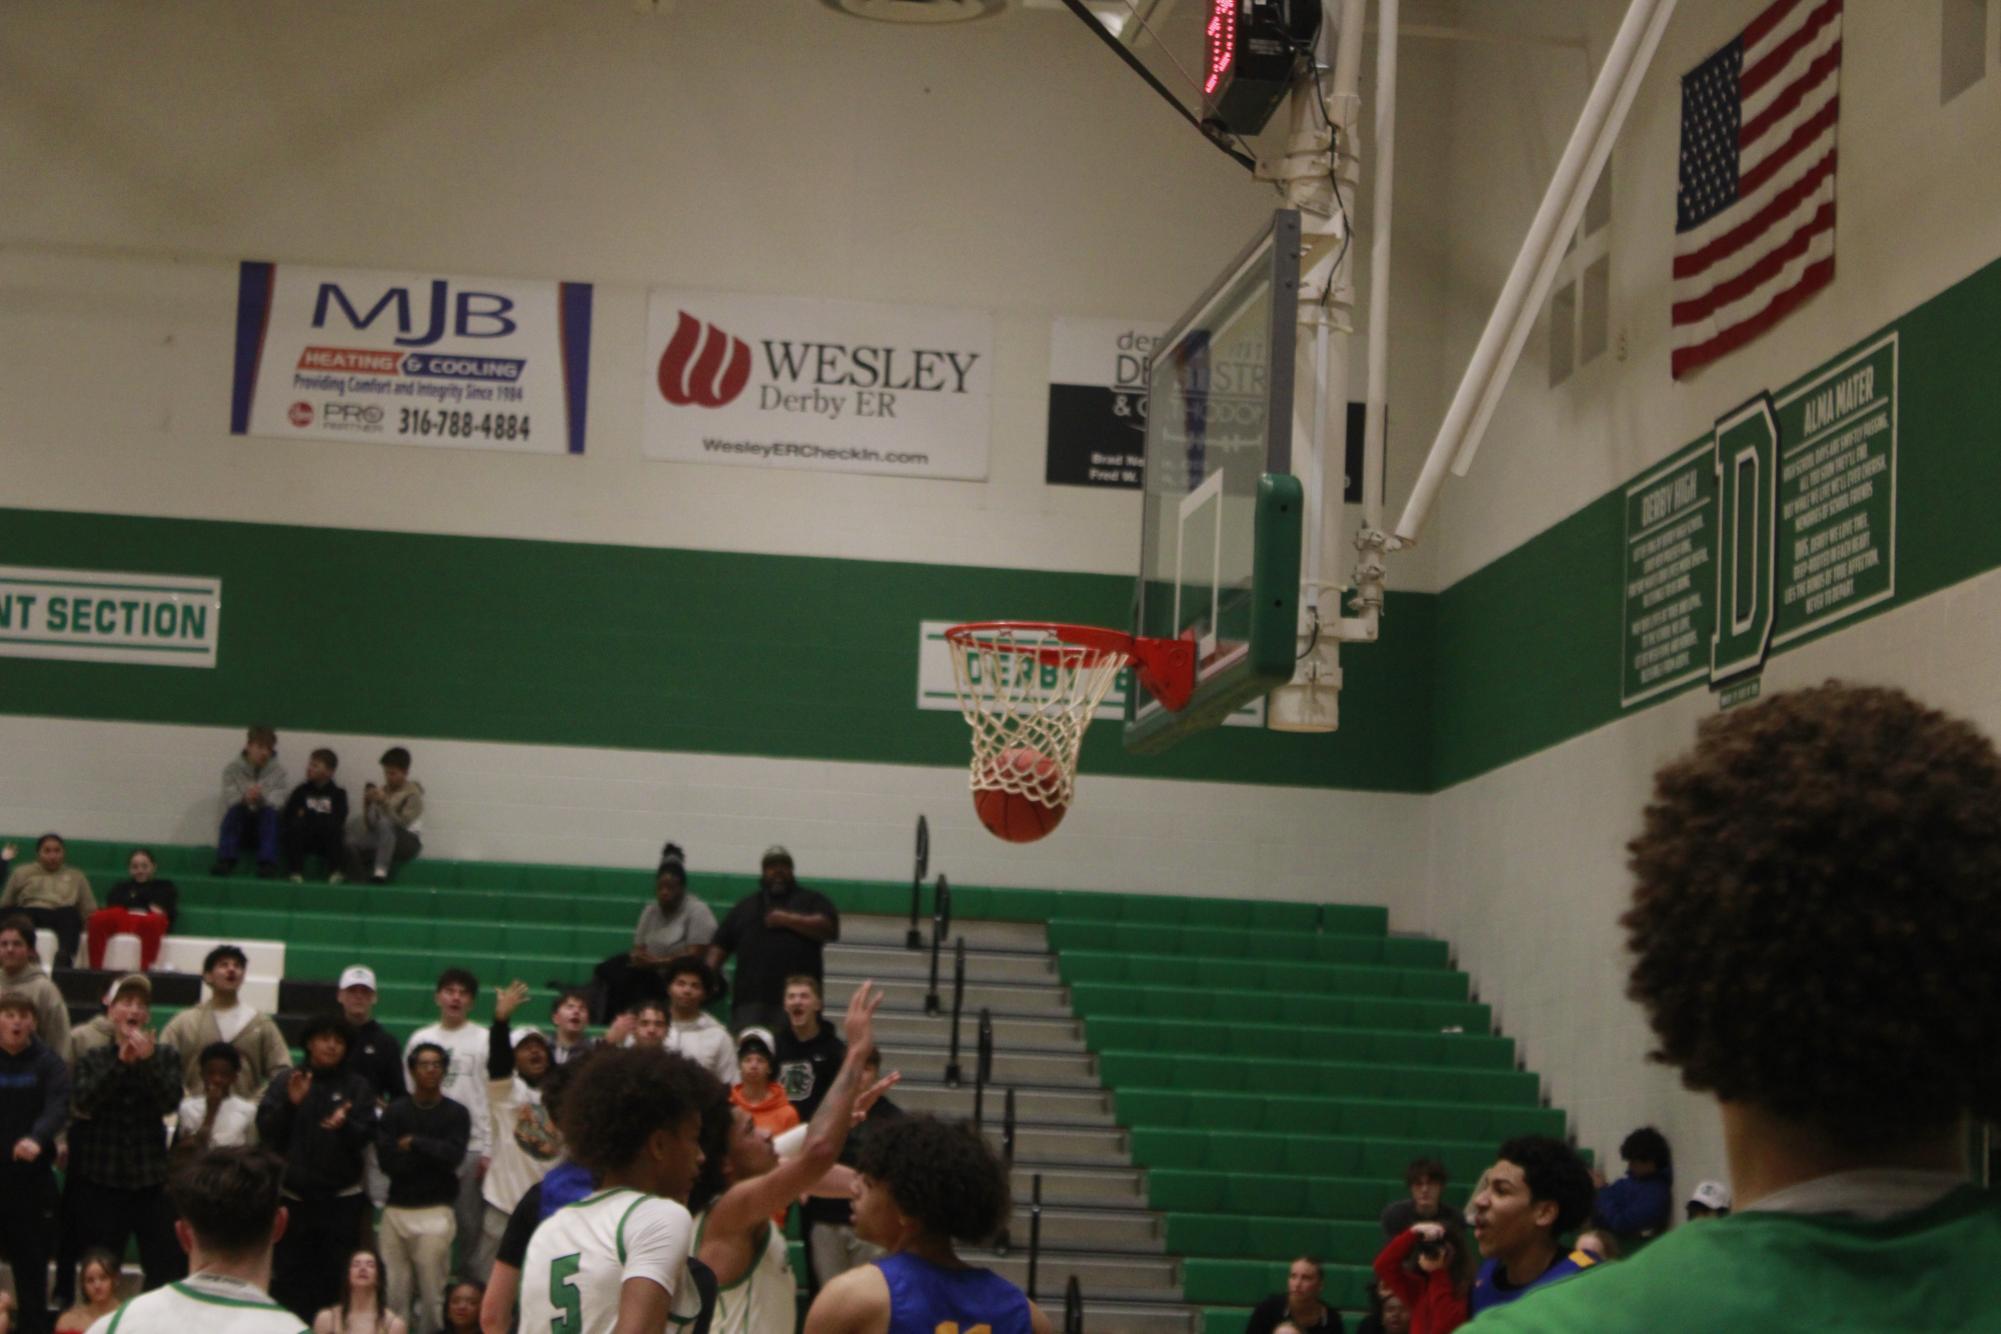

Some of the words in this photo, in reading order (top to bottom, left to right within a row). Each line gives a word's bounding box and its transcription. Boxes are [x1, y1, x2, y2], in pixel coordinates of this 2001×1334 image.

[311, 279, 517, 346] MJB
[304, 351, 394, 371] HEATING
[406, 358, 421, 372] &
[429, 358, 518, 378] COOLING
[760, 338, 980, 394] WESLEY
[294, 373, 345, 395] Providing
[348, 376, 391, 393] Comfort
[393, 380, 415, 396] and
[417, 382, 463, 403] Integrity
[465, 384, 494, 402] Since
[759, 384, 847, 420] Derby
[855, 391, 897, 418] ER
[1112, 395, 1132, 417] &
[1804, 387, 1835, 438] ALMA
[1836, 364, 1874, 419] MATER
[323, 403, 384, 424] PRO
[397, 407, 531, 441] 316-788-4884
[1711, 388, 1781, 692] D
[46, 596, 207, 640] SECTION
[549, 1252, 583, 1334] 5
